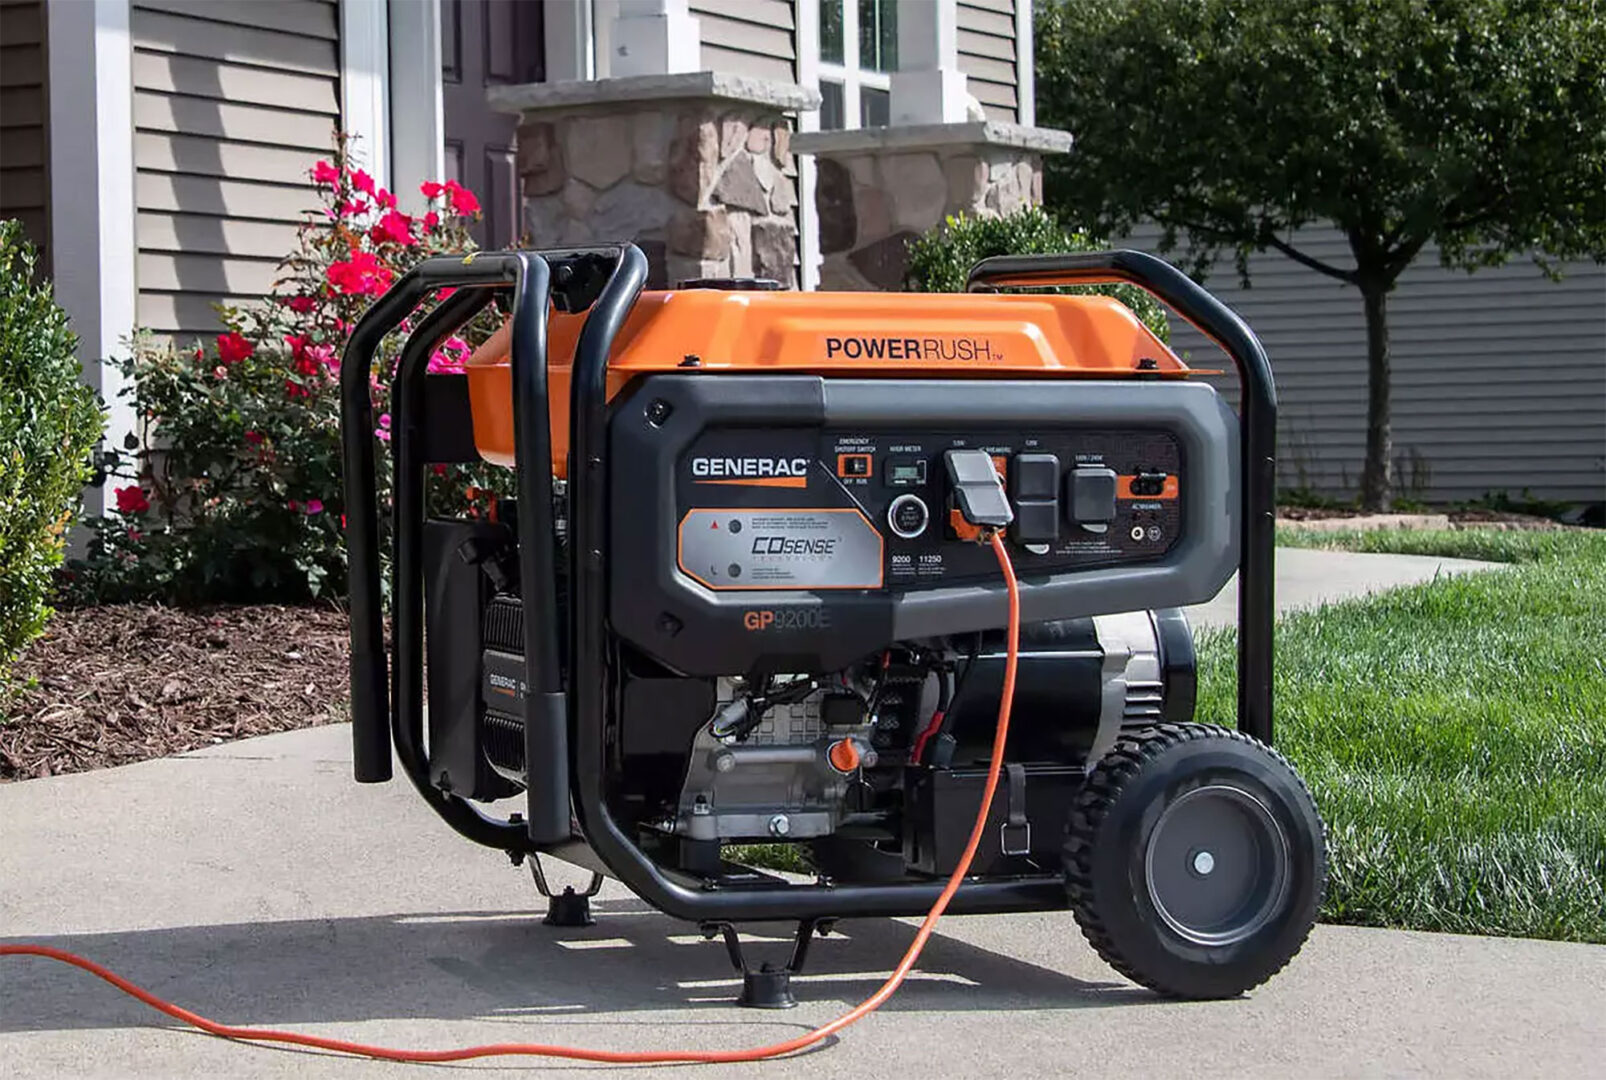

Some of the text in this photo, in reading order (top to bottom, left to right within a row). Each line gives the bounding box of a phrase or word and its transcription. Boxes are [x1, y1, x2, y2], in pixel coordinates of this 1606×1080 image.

[826, 337, 990, 361] POWERRUSH
[692, 457, 808, 476] GENERAC
[892, 555, 943, 564] 9200 11250
[744, 609, 832, 631] GP9200E
[490, 674, 515, 690] GENERAC
